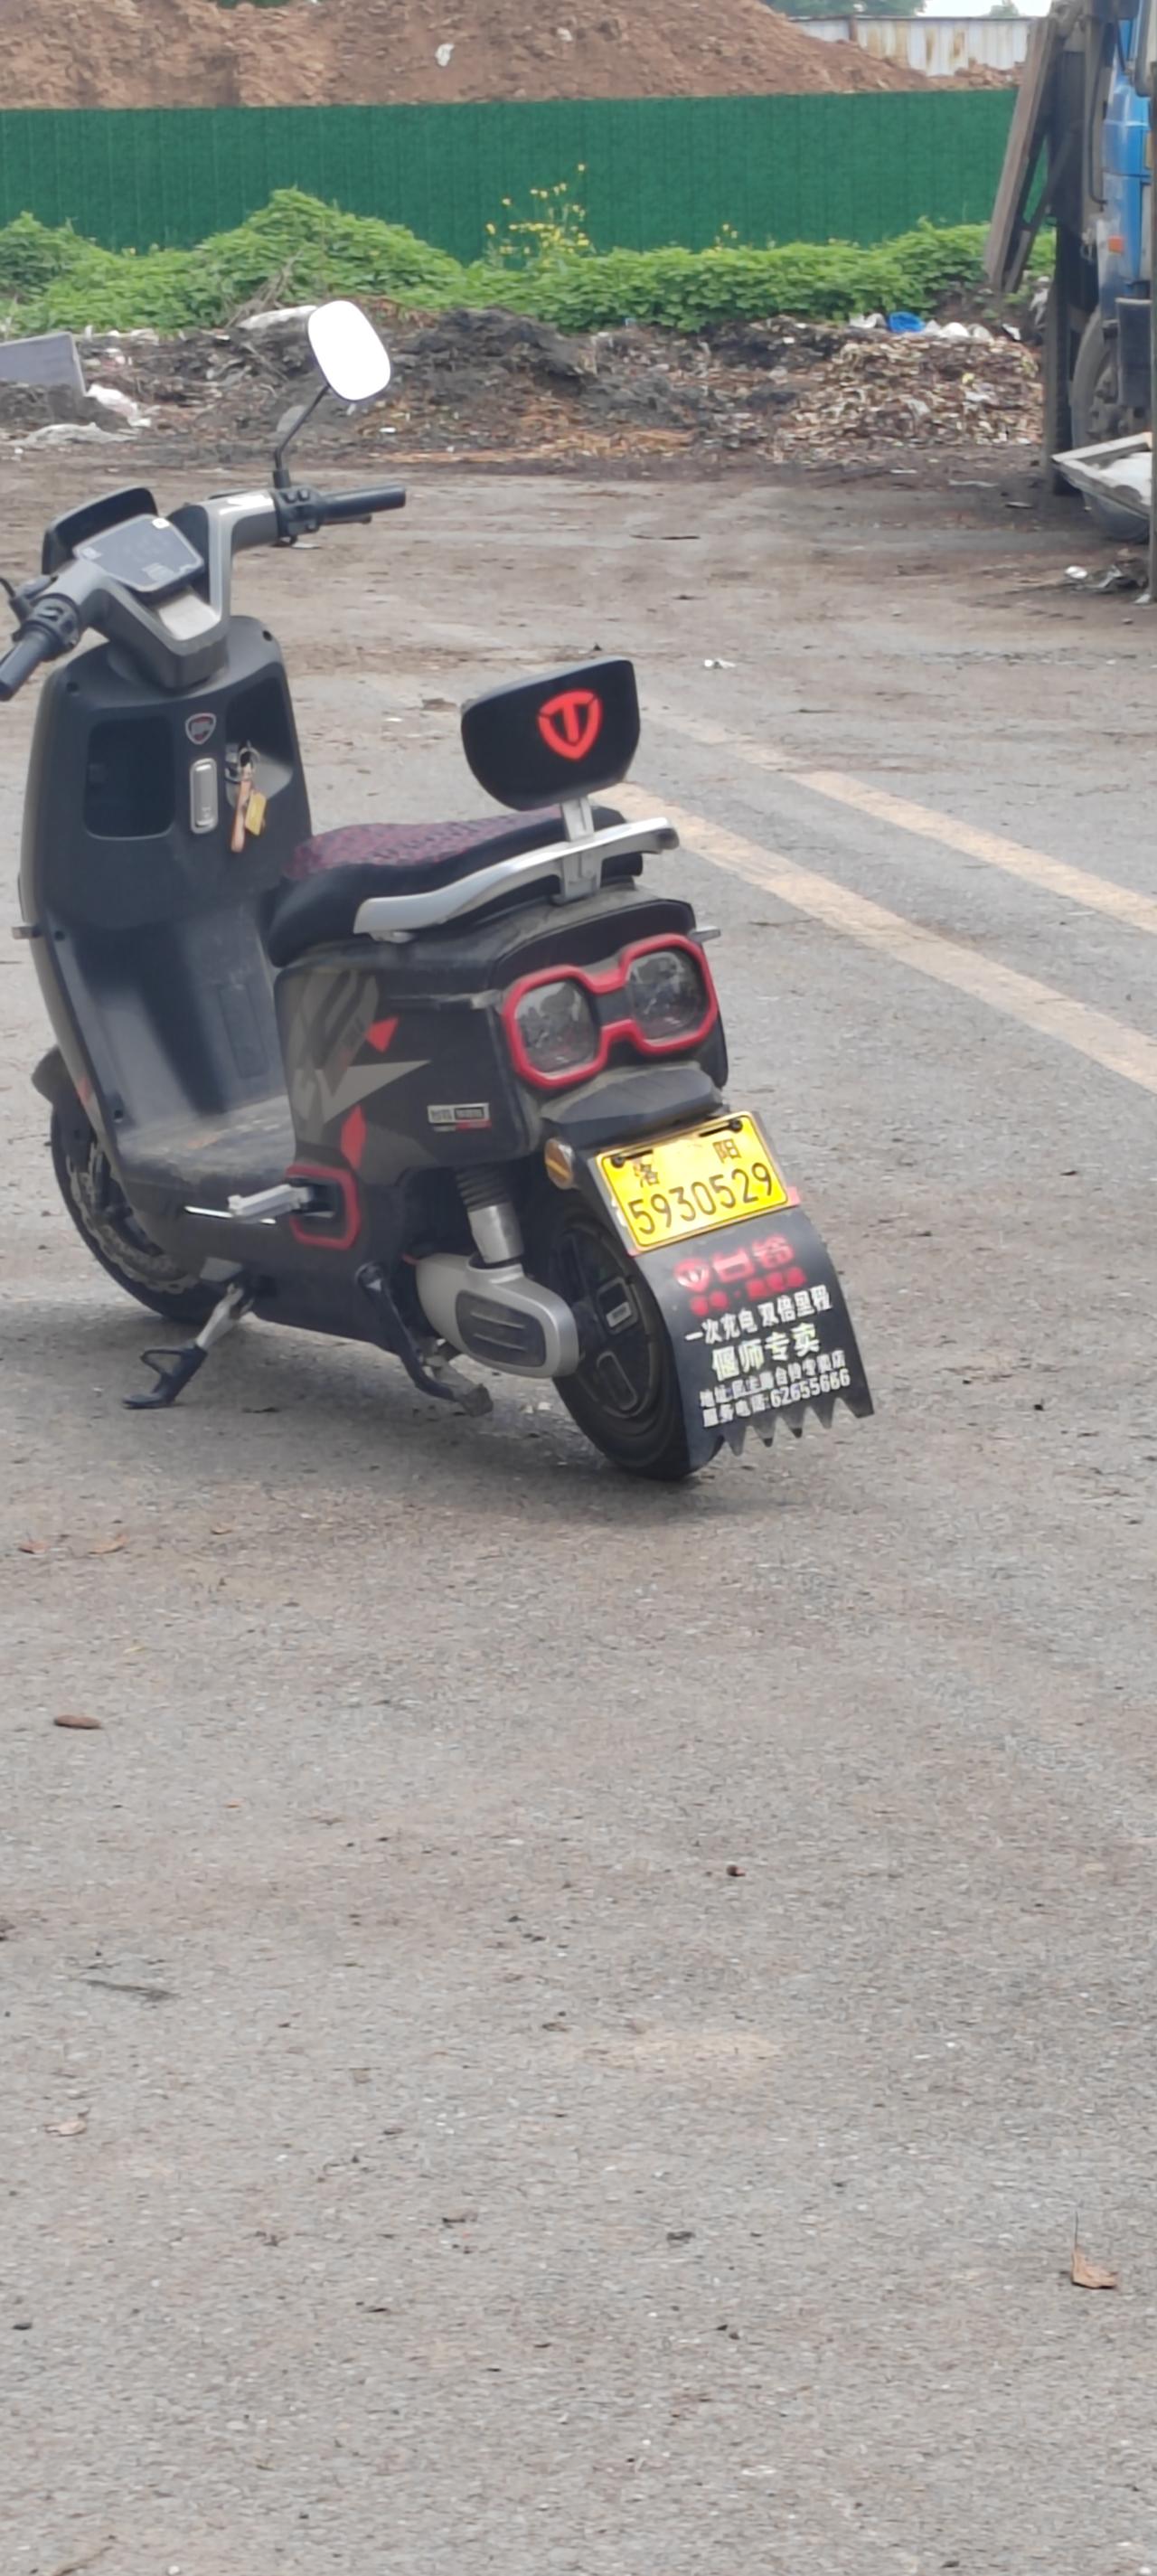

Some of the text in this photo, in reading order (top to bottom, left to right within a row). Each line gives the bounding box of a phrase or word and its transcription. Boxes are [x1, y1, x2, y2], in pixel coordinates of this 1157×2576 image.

[627, 1162, 773, 1234] 5930529
[684, 1308, 758, 1345] 一次充电
[757, 1284, 832, 1326] 双倍里程
[711, 1322, 820, 1382] 偃师专卖
